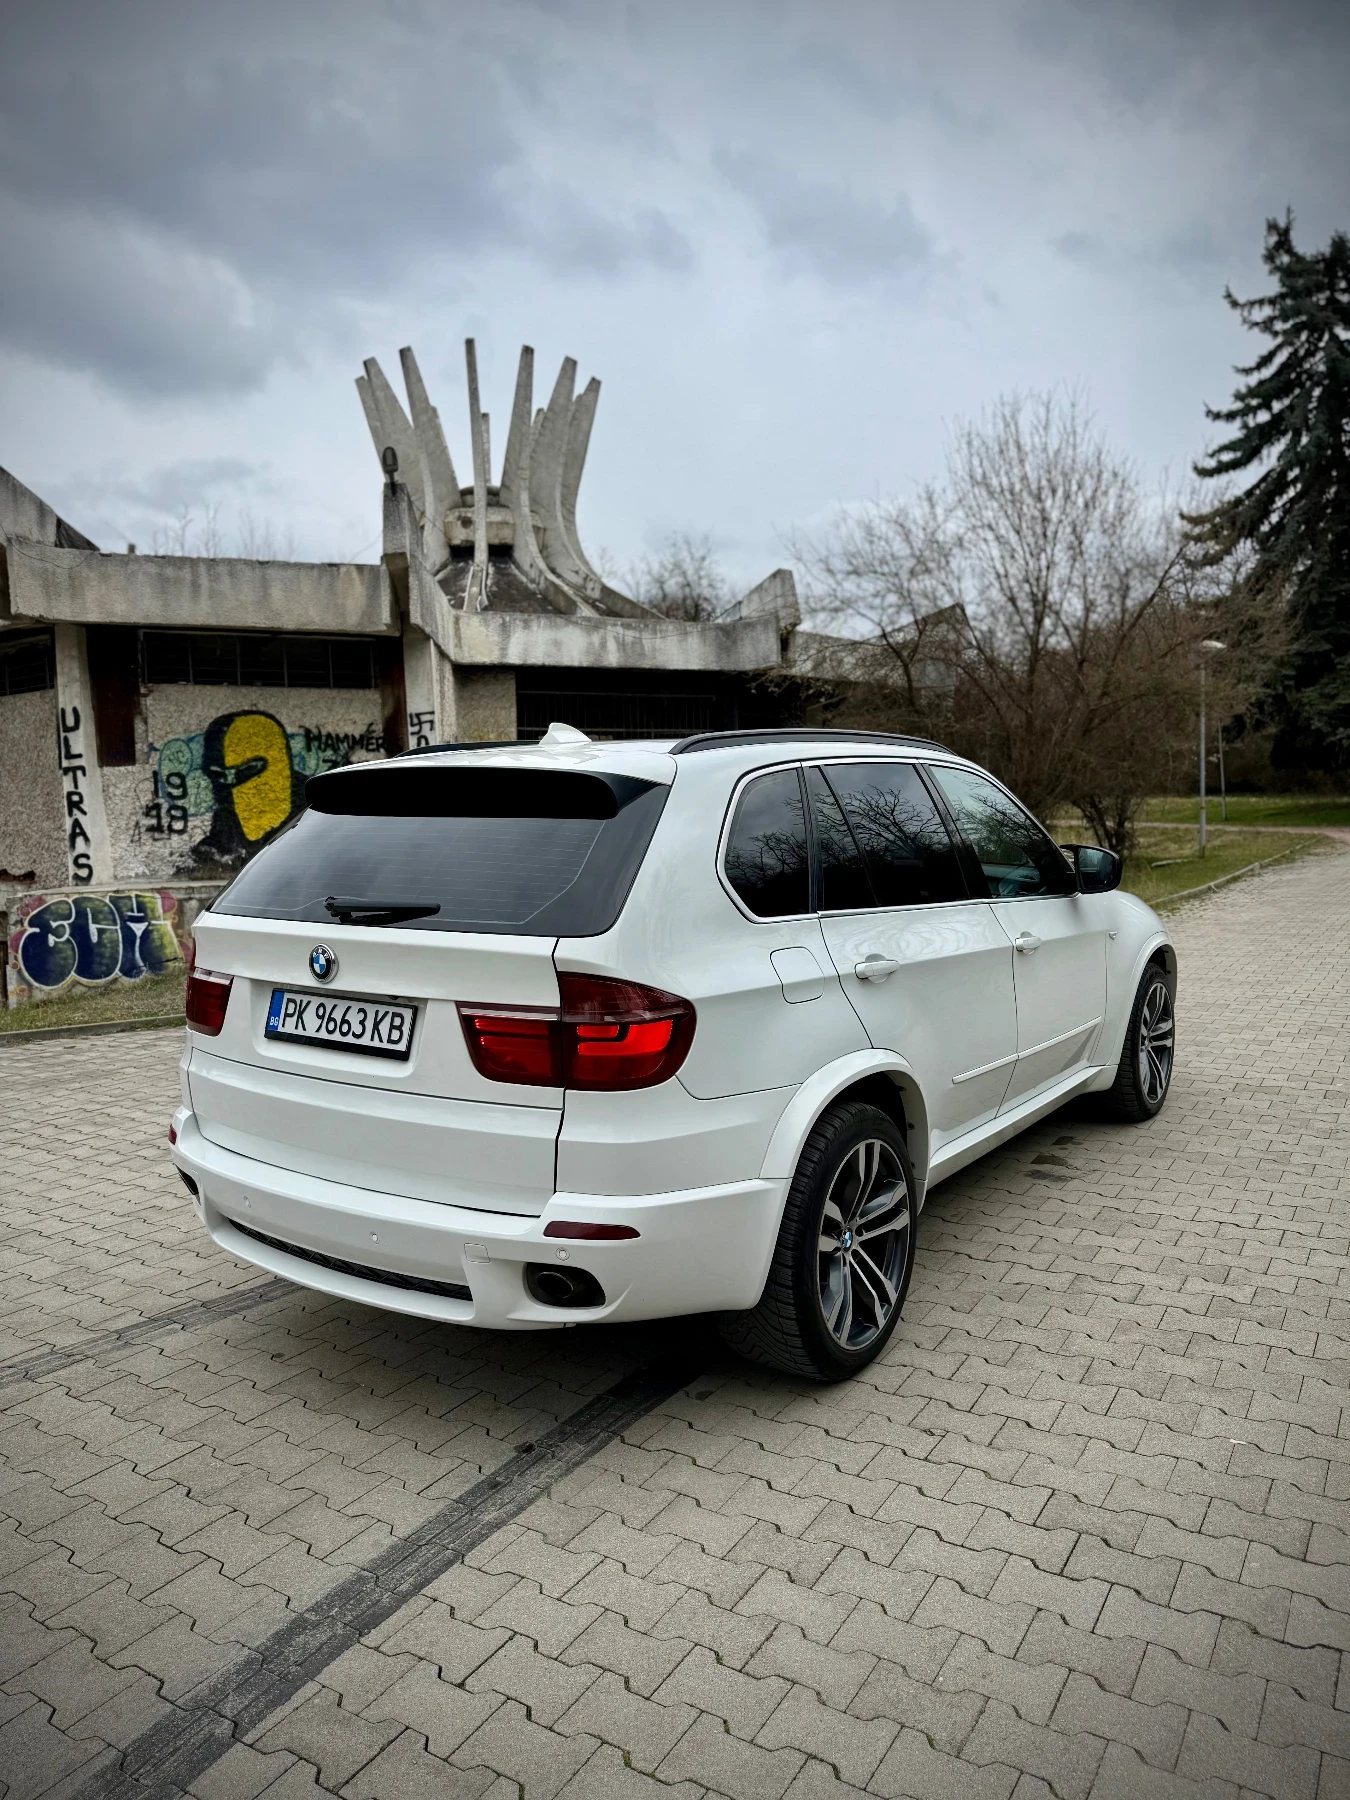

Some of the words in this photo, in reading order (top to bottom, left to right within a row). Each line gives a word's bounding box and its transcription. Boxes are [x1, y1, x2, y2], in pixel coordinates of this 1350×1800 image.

[61, 706, 94, 885] ULTRAS
[269, 1016, 279, 1026] BG
[282, 997, 312, 1031] PK
[315, 1002, 368, 1040] 9663
[370, 1009, 406, 1045] KB
